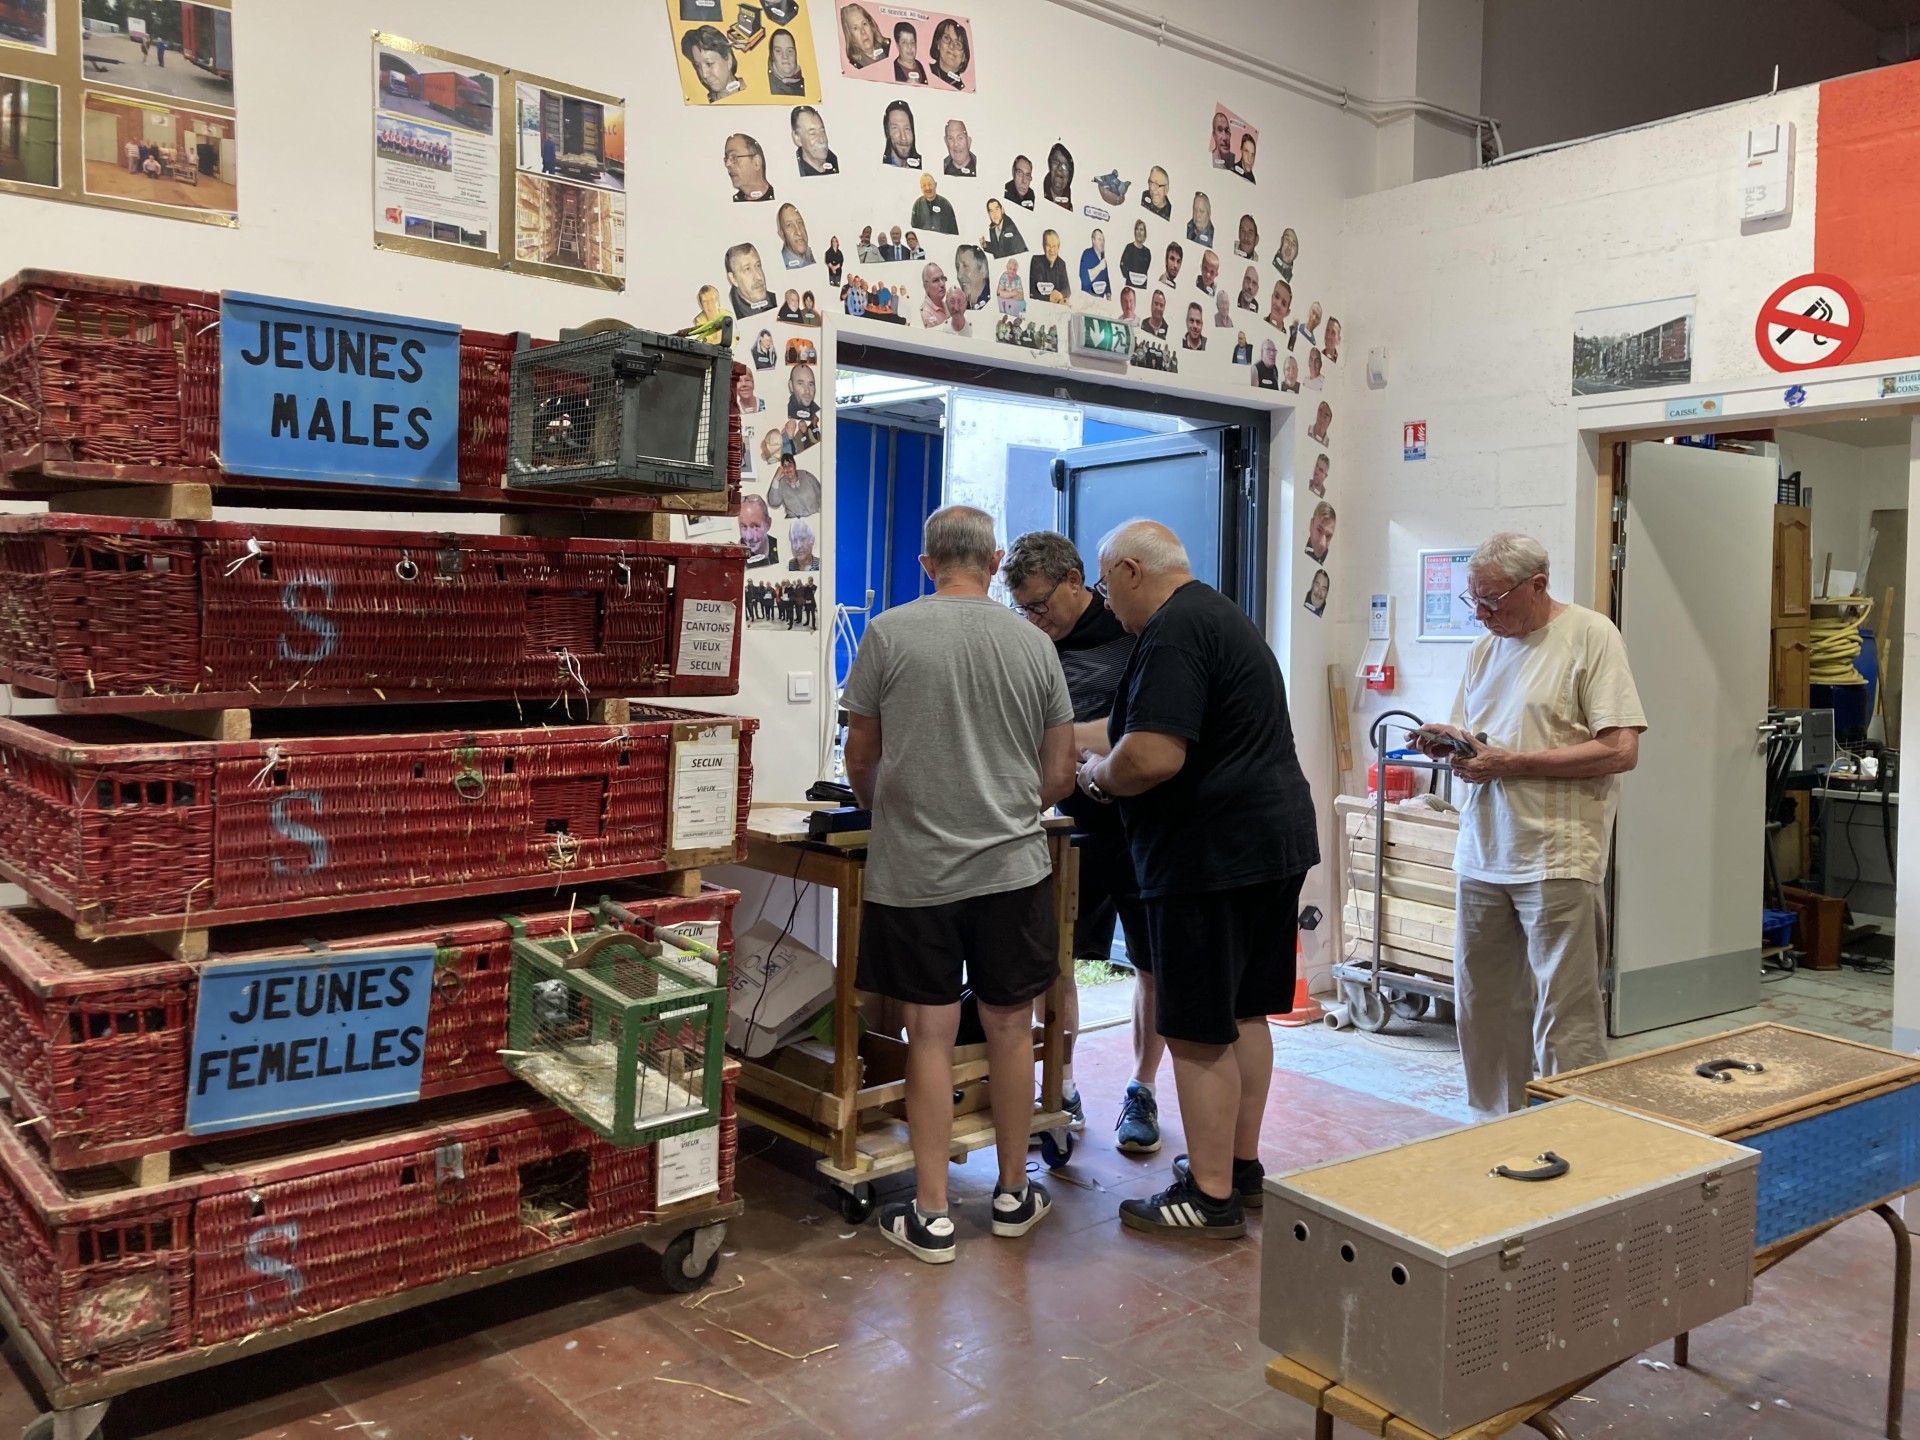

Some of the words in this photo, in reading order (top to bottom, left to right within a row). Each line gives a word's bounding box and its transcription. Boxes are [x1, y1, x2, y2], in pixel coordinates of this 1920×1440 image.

[386, 176, 415, 187] MECHOUI
[416, 181, 436, 191] GEANT
[1745, 186, 1755, 217] TYPE
[1756, 184, 1767, 202] 3
[656, 334, 695, 351] MALE
[240, 320, 426, 383] JEUNES
[1898, 374, 1920, 383] REG
[1669, 408, 1698, 418] CAISSE
[271, 393, 433, 450] MALES
[654, 471, 691, 488] MALE
[696, 602, 721, 613] DEUX
[279, 571, 336, 661] S
[686, 621, 730, 633] CANTONS
[693, 641, 720, 652] VIEUX
[690, 660, 721, 671] SECLIN
[691, 757, 722, 768] SECLIN
[697, 785, 716, 793] VIEUX
[272, 790, 328, 876] S
[229, 966, 414, 1024] JEUNES
[197, 1025, 424, 1096] FEMELLES
[681, 1139, 699, 1148] VIEUX
[245, 1220, 304, 1310] S
